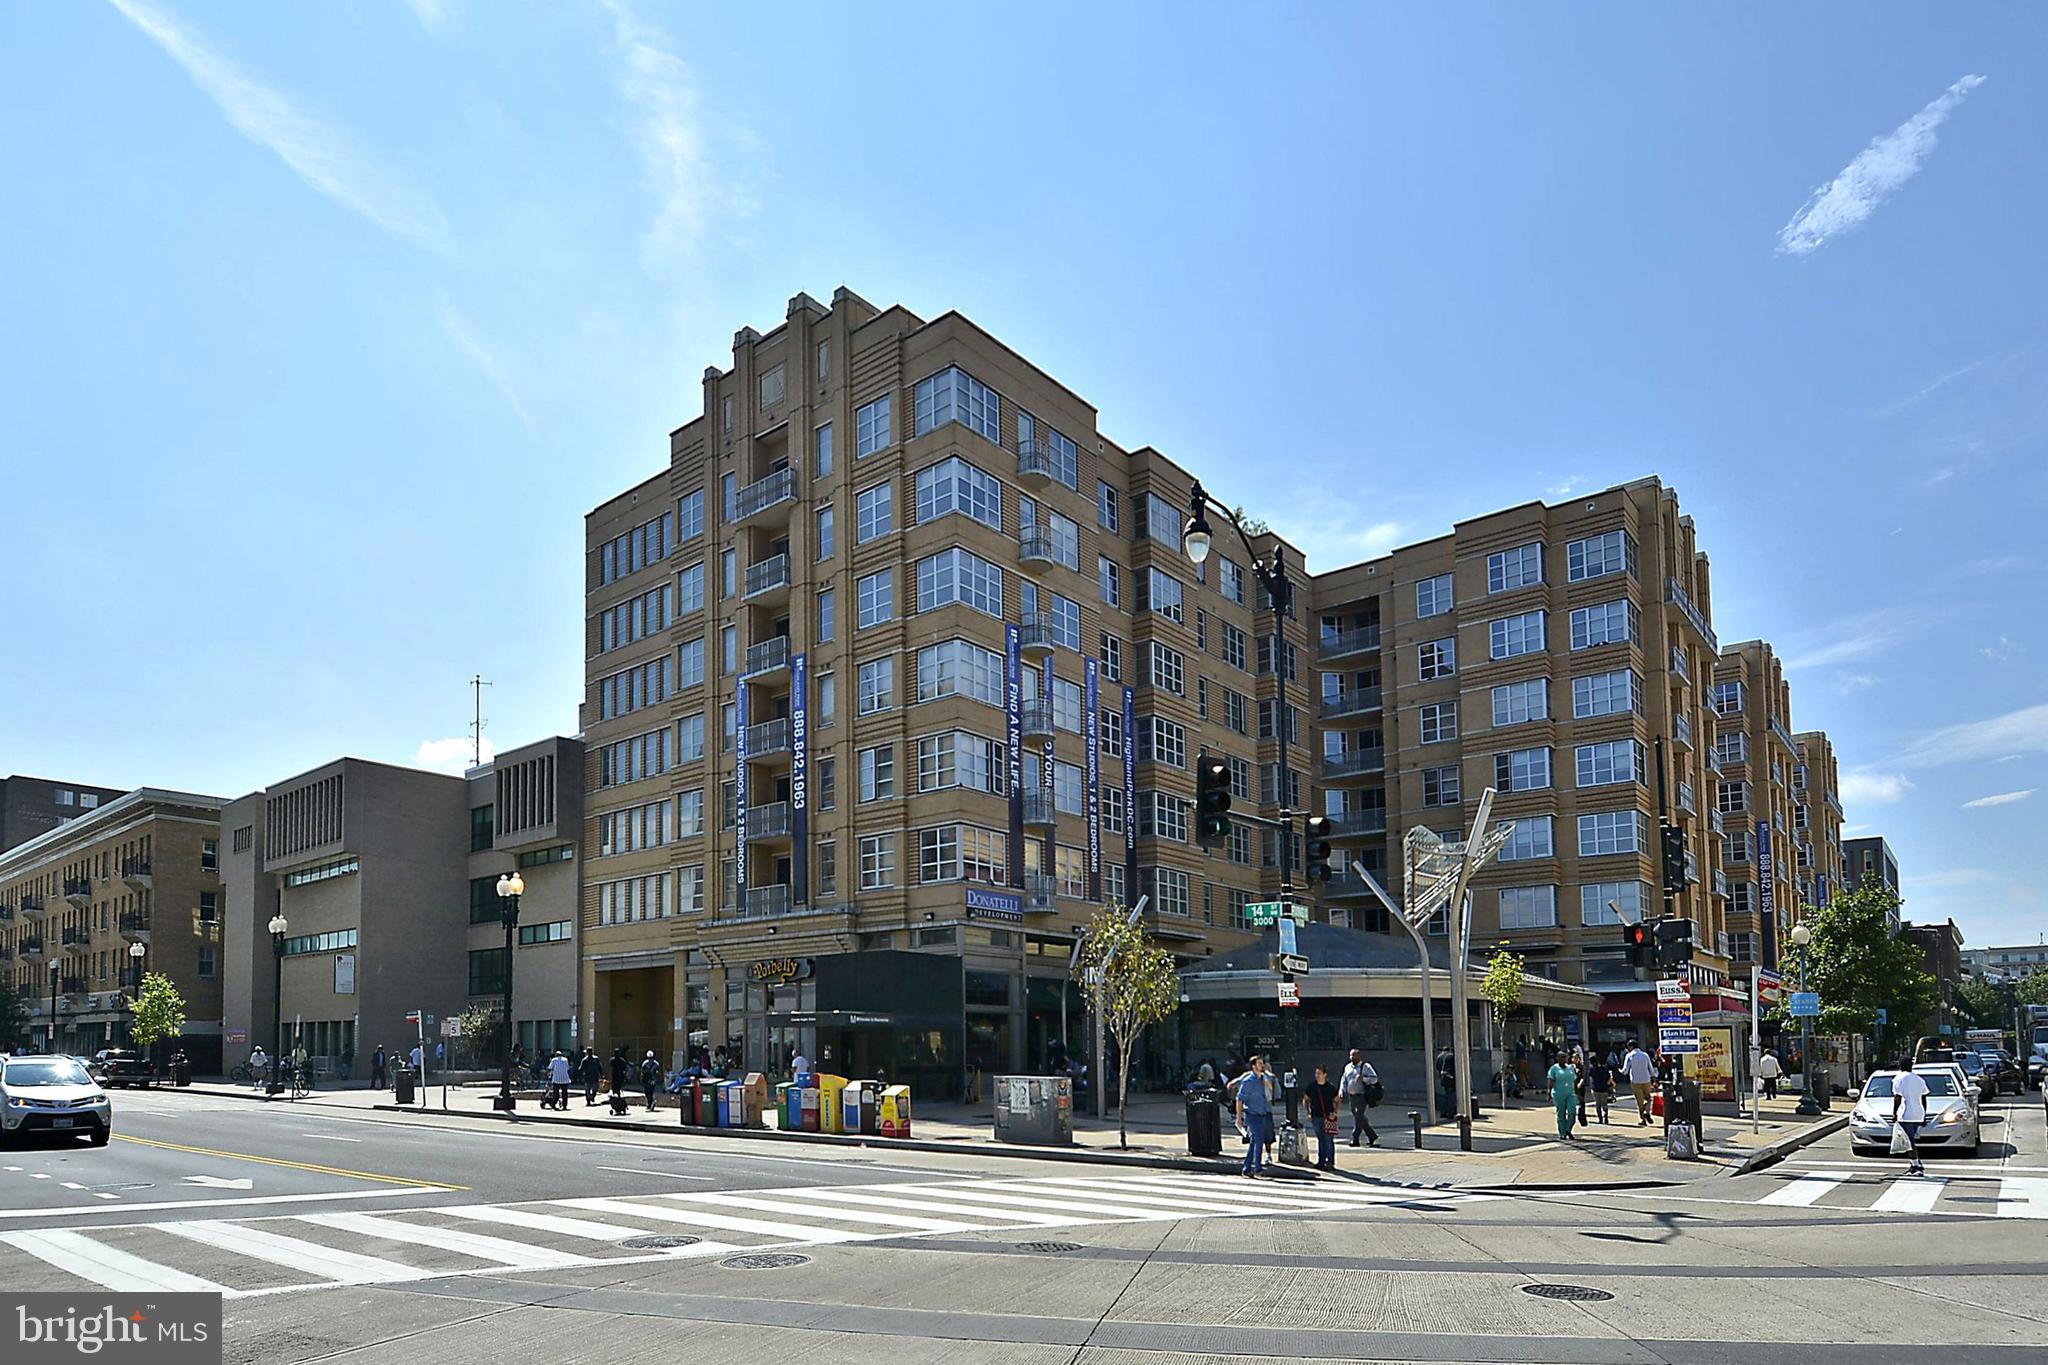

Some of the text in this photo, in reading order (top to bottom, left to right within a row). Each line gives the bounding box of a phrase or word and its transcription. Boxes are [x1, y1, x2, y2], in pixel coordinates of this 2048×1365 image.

[1009, 683, 1019, 712] FIND
[1010, 715, 1019, 724] A
[737, 725, 745, 750] NEW
[1010, 728, 1019, 758] NEW
[794, 710, 804, 809] 888.842.1963
[1045, 754, 1053, 786] YOUR
[1010, 761, 1019, 797] LIFE...
[1124, 737, 1134, 848] HighlandParkDC.com
[1090, 815, 1098, 872] BEDROOMS
[1760, 854, 1773, 913] 888.842.1963
[967, 890, 1018, 910] DONATELLI
[1251, 906, 1263, 916] 14
[1253, 917, 1273, 926] 3000
[753, 956, 797, 981] Potbelly
